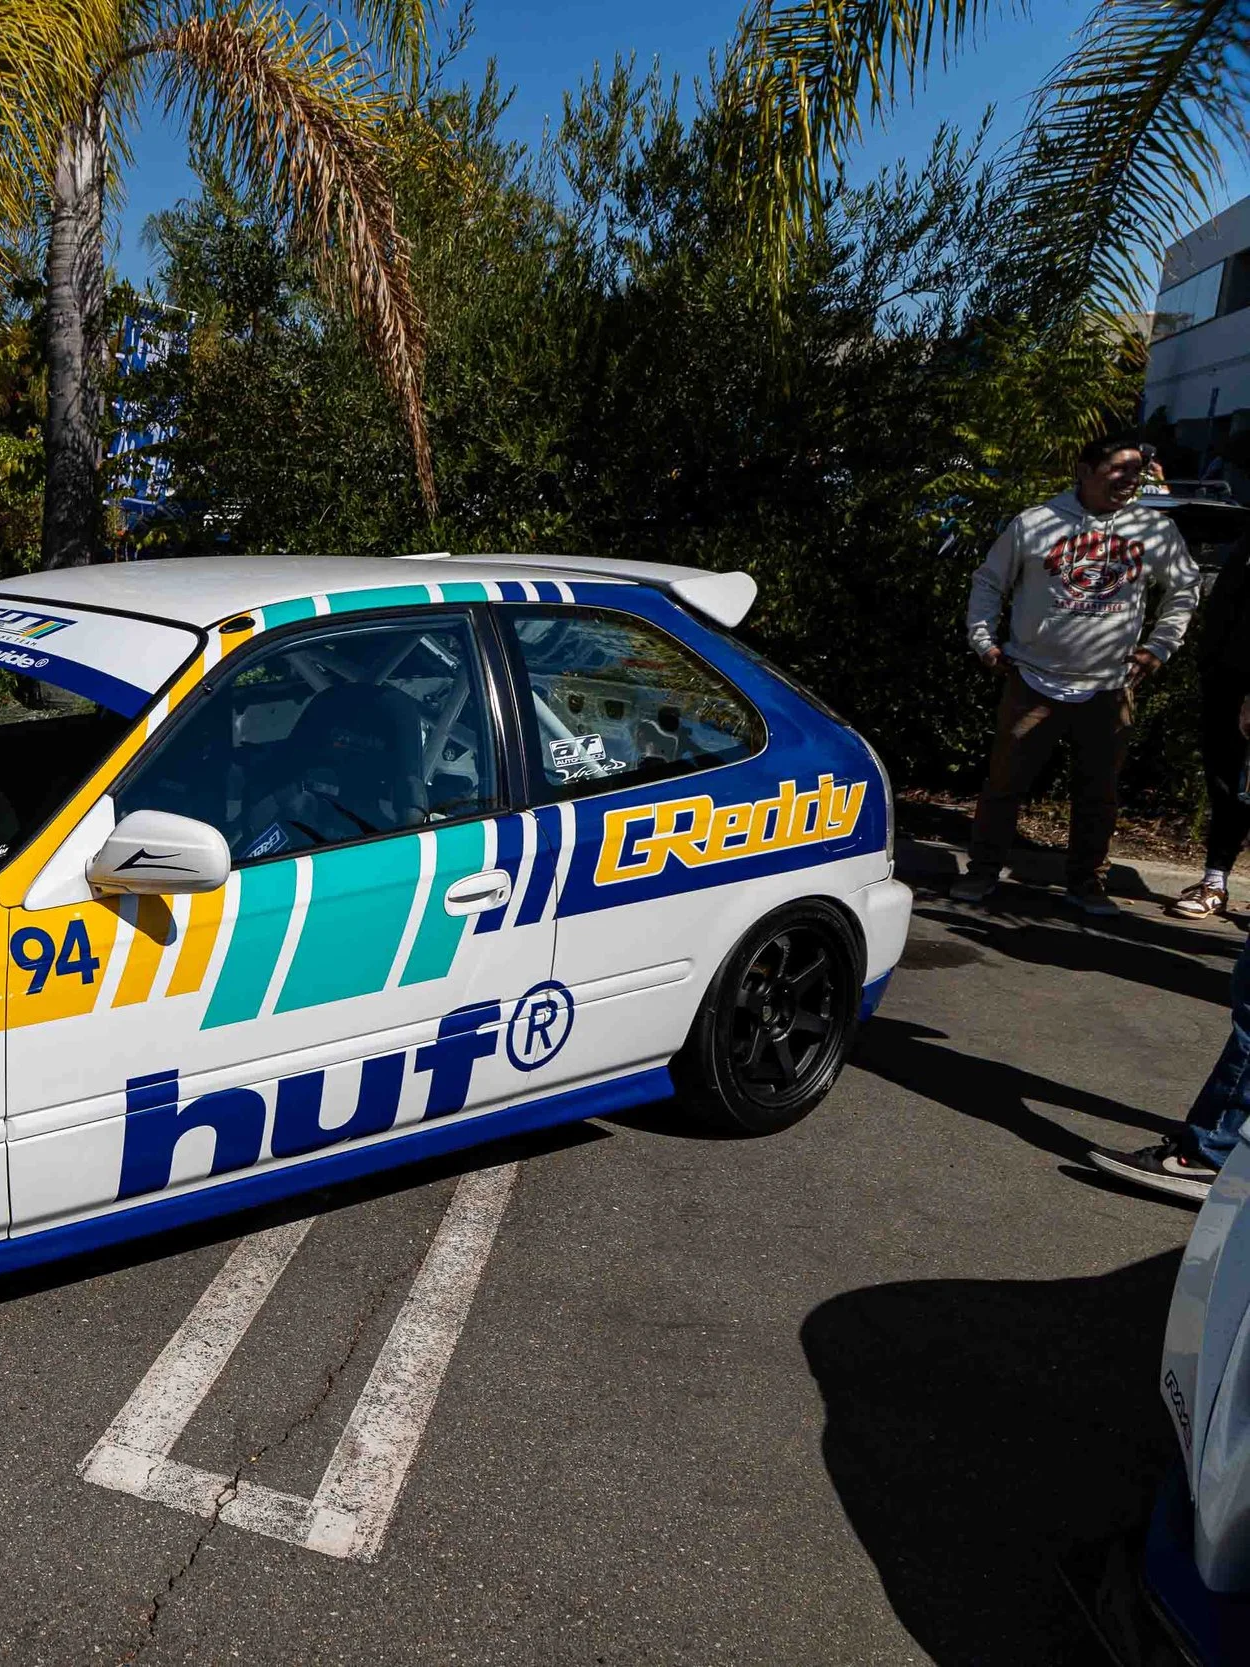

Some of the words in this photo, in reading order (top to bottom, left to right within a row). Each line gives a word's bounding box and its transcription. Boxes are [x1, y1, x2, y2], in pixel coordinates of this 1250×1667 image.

[13, 637, 38, 647] TEAM
[592, 772, 868, 887] GReddy
[10, 918, 100, 996] 94
